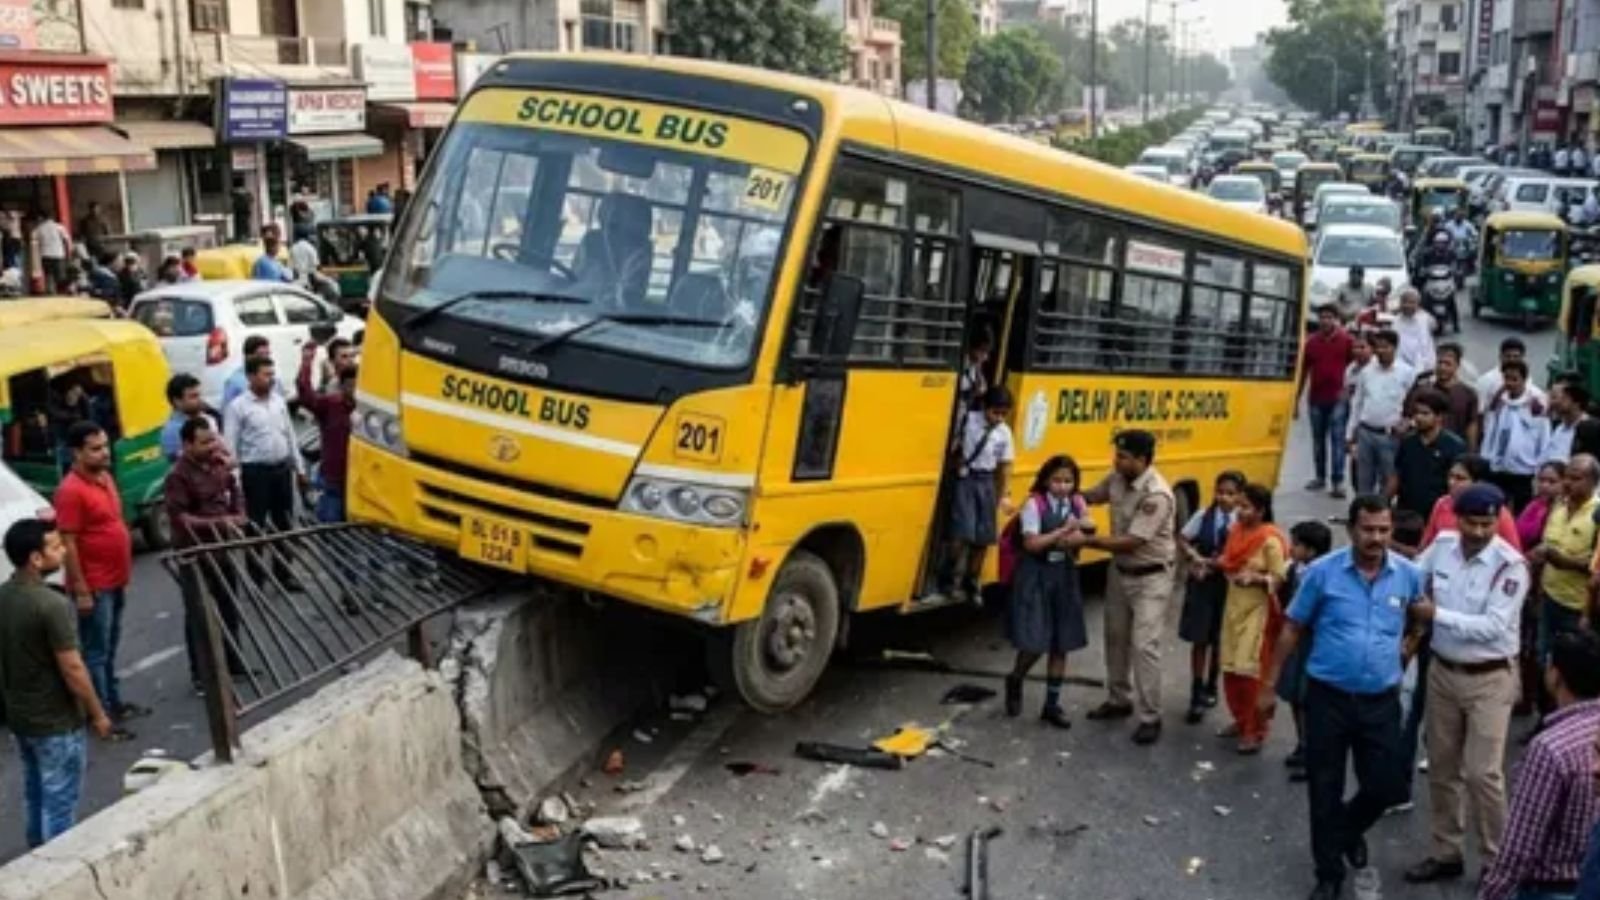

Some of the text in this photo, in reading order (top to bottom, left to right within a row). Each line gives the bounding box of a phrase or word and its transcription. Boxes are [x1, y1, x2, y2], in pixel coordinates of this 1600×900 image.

[10, 72, 108, 105] SWEETS
[518, 96, 729, 149] SCHOOL BUS
[747, 175, 784, 203] 201
[442, 375, 590, 430] SCHOOL BUS
[1057, 388, 1228, 422] DELHI PUBLIC SCHOOL
[678, 421, 719, 455] 201
